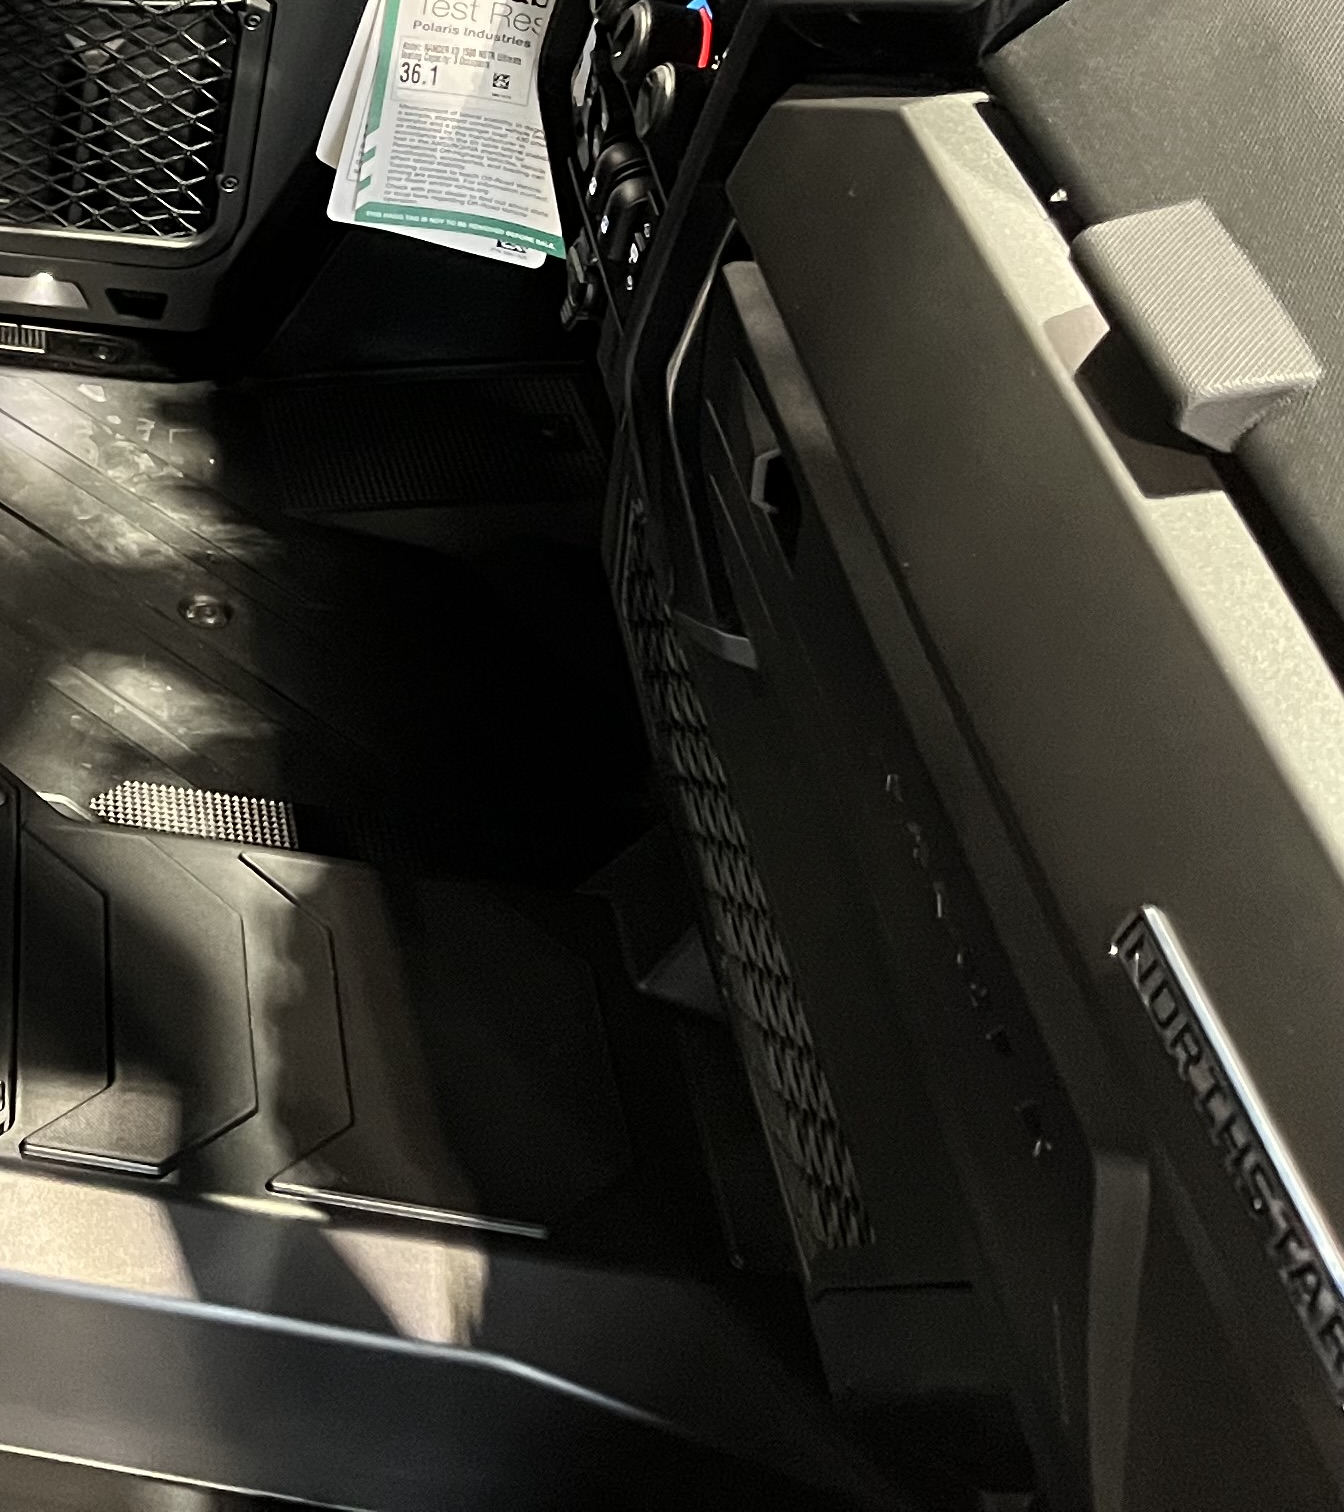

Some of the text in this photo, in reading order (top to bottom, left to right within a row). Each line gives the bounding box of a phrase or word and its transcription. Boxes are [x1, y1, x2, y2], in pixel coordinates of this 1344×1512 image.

[412, 19, 531, 49] Polaris Industries
[400, 61, 438, 86] 36.1
